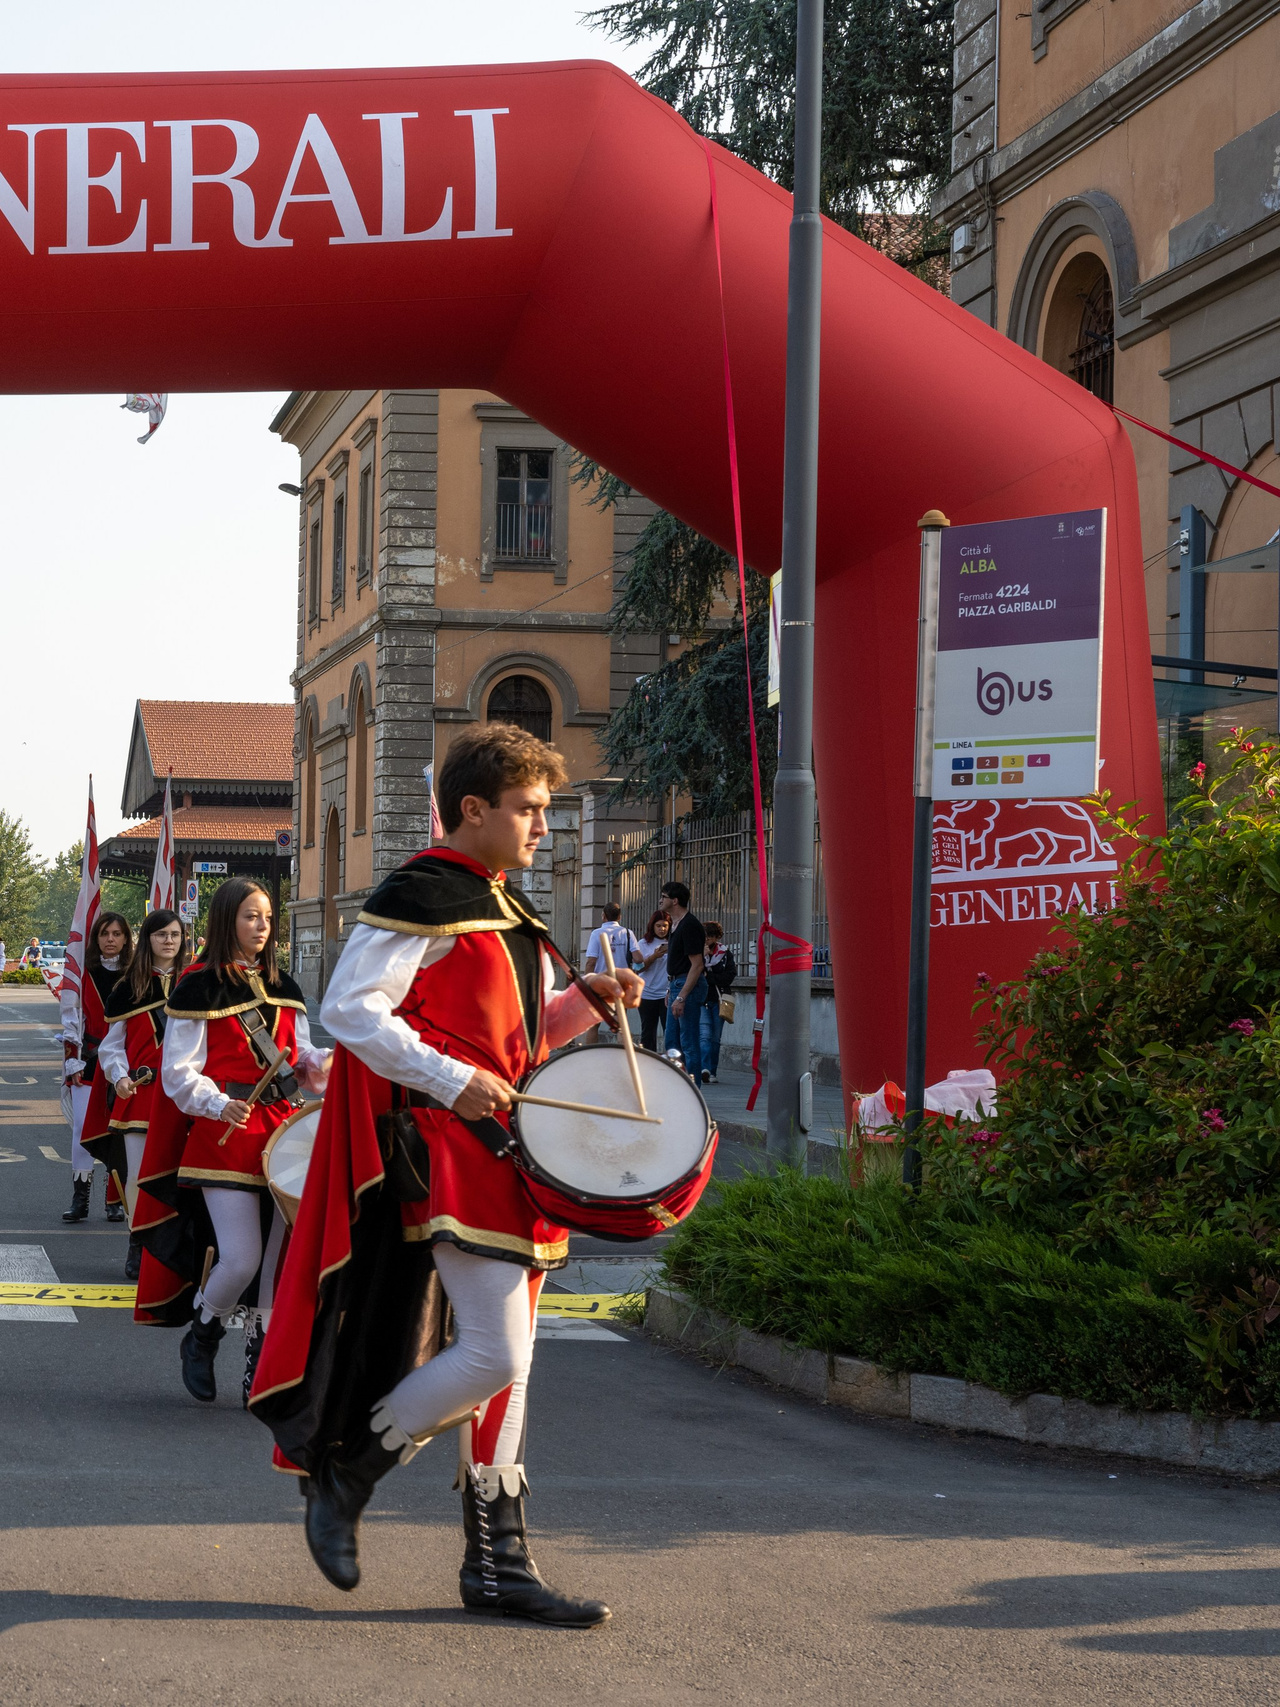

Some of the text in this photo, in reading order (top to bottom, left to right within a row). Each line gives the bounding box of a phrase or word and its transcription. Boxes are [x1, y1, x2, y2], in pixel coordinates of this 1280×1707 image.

[960, 544, 991, 556] Città di
[960, 559, 997, 574] ALBA
[959, 583, 1030, 602] Fermata 4224
[959, 599, 1057, 617] PIAZZA GARIBALDI
[942, 842, 959, 850] GELI
[942, 849, 957, 857] STA
